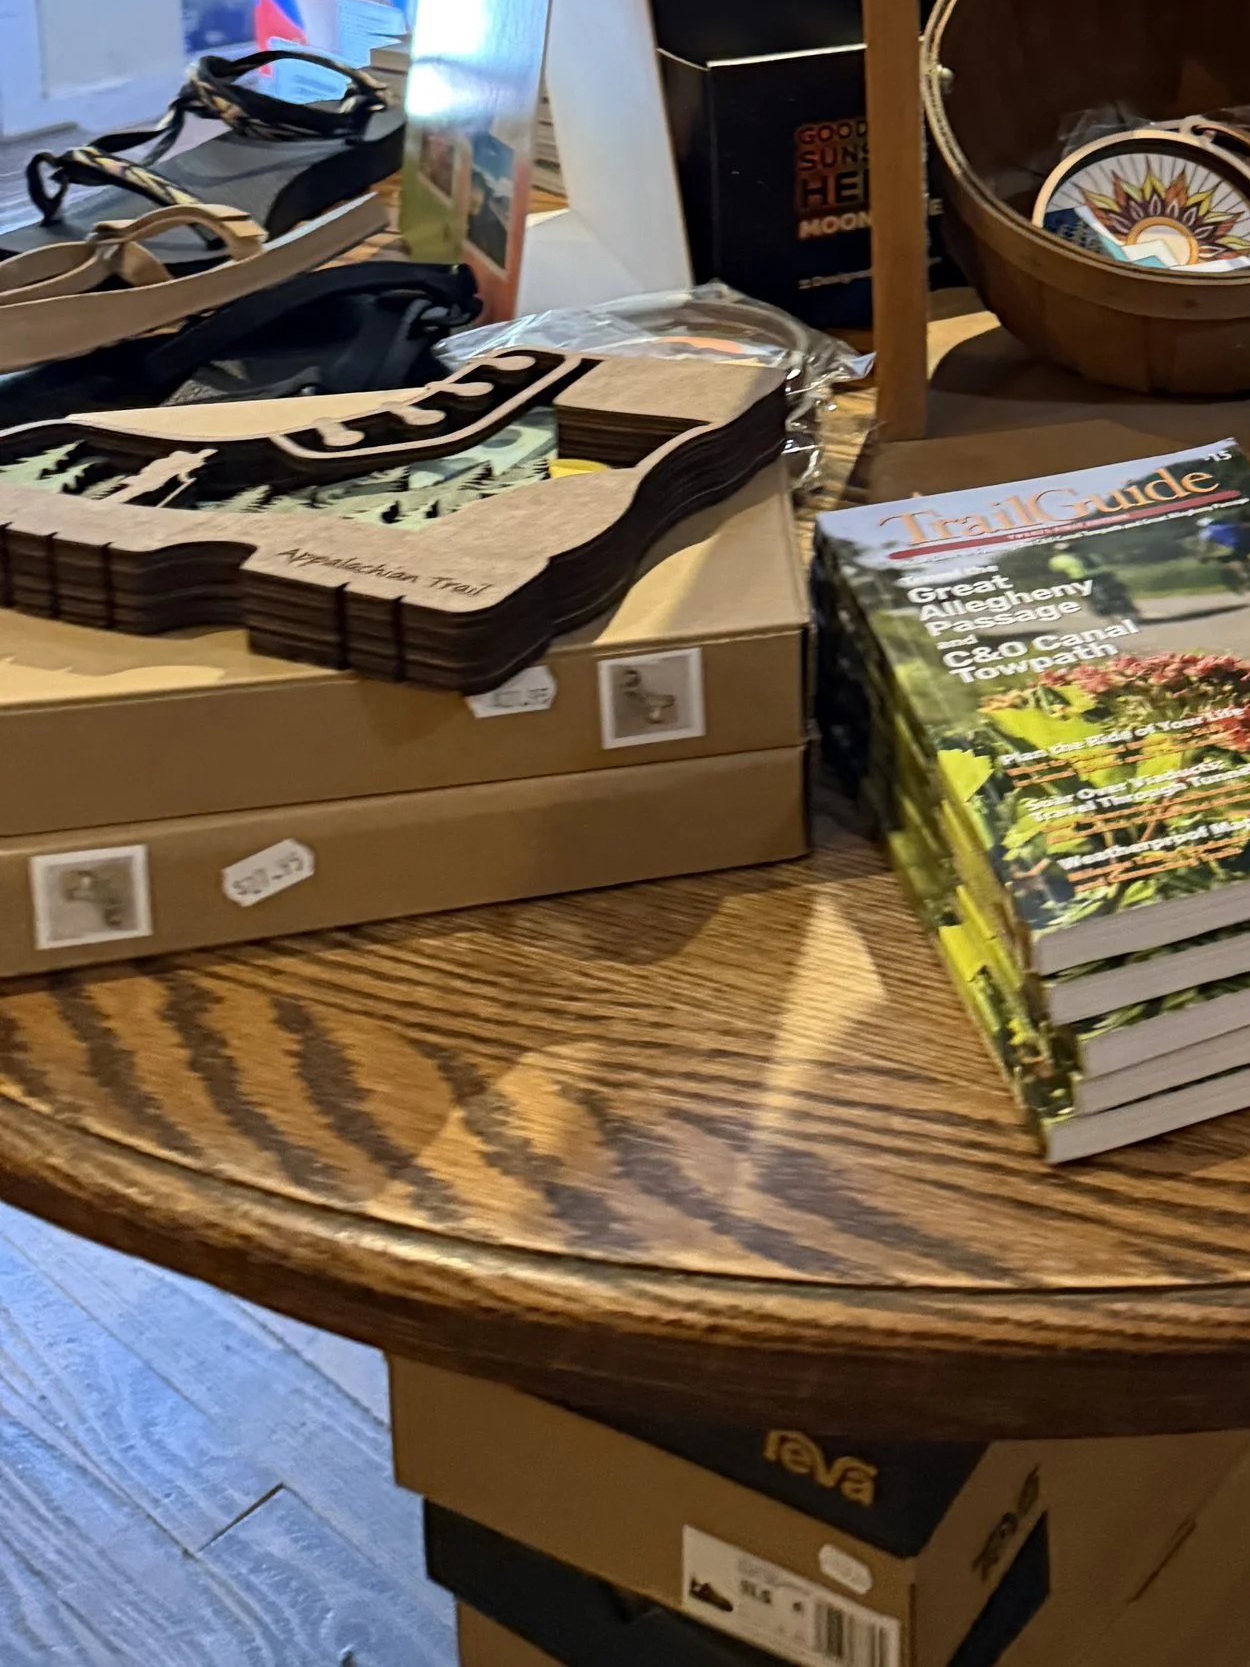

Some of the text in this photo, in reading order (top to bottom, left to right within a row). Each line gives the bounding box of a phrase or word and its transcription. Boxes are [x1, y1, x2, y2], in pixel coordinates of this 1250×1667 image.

[880, 467, 1220, 545] TrailGuide
[278, 546, 493, 597] Appalachian Trail
[907, 573, 1013, 604] Great
[920, 579, 1094, 622] Allegheny
[924, 599, 1082, 637] Passage
[936, 634, 979, 650] and
[942, 618, 1141, 668] C&O Canal
[948, 642, 1119, 683] Towpath
[999, 749, 1047, 766] Plan
[1050, 741, 1085, 755] the
[1086, 729, 1134, 747] Ride
[1134, 724, 1157, 738] of
[1158, 715, 1203, 732] Your
[1203, 706, 1246, 723] Life
[1030, 799, 1099, 823] Travel
[1098, 781, 1188, 809] Through
[1076, 781, 1127, 800] Over
[1057, 825, 1209, 871] Weatherproof
